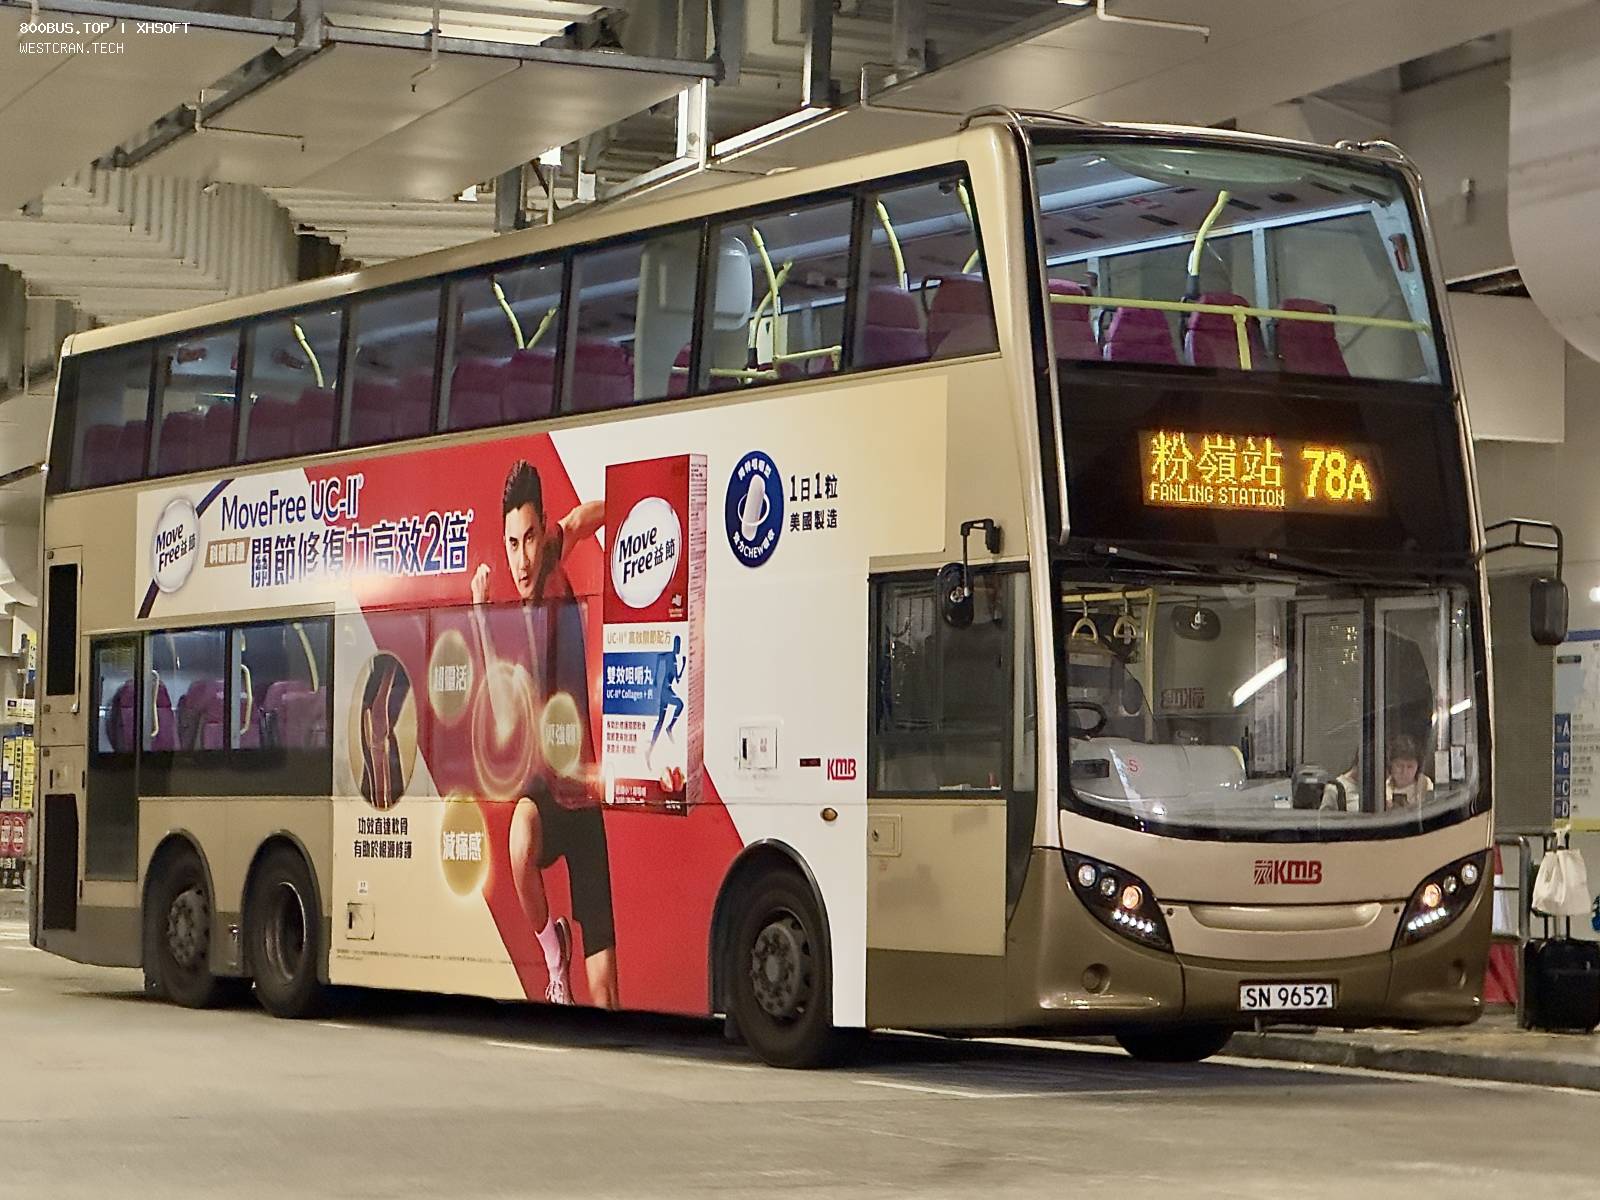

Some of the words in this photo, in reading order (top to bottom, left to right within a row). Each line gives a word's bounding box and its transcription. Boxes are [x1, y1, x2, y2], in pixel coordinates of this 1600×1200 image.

[1151, 430, 1283, 487] 粉嶺站
[1303, 450, 1371, 500] 78A
[789, 472, 838, 502] 1日1粒
[1150, 483, 1213, 503] FANLING
[1219, 489, 1285, 506] STATION
[221, 489, 306, 531] MoveFree
[789, 508, 838, 532] 美國製造
[156, 524, 184, 554] Move
[618, 526, 658, 563] Move
[358, 816, 408, 836] 功效直達軟骨
[1246, 987, 1271, 1008] SN
[1278, 986, 1328, 1007] 9652
